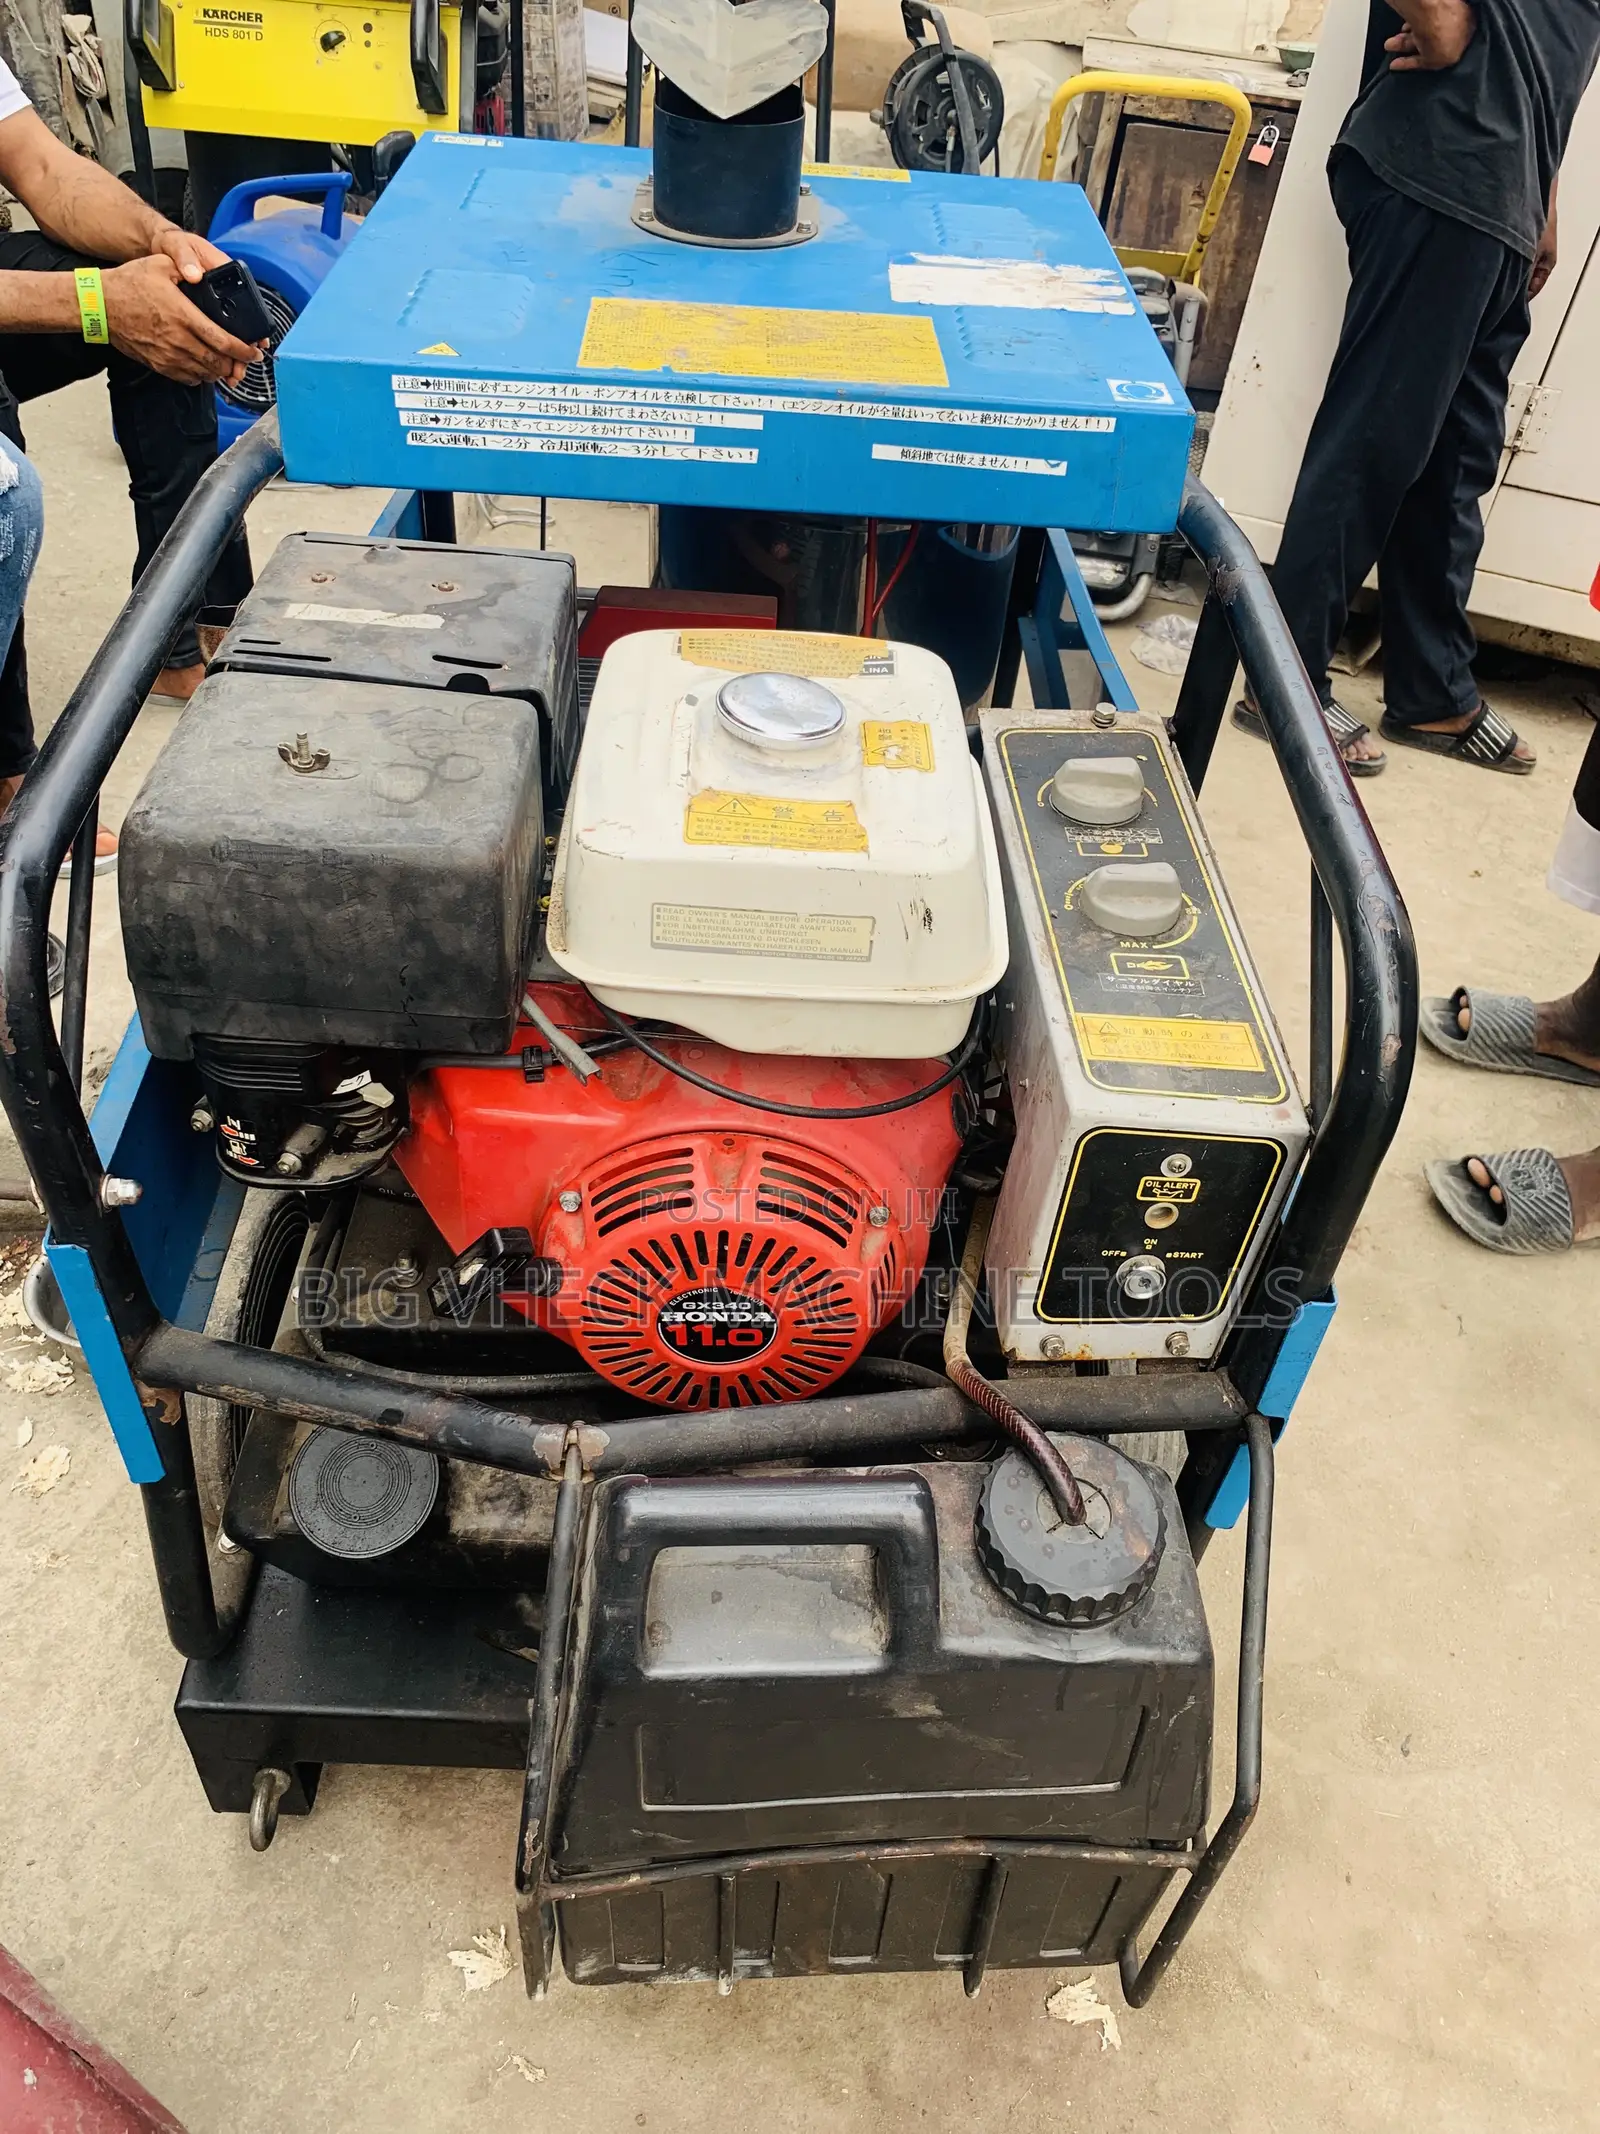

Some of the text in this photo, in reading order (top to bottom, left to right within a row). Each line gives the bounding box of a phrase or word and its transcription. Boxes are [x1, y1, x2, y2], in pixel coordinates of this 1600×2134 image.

[202, 7, 263, 23] KÄRCHER
[205, 27, 263, 41] HDS 801 D
[397, 377, 421, 390] 注意
[424, 396, 448, 408] 注意
[406, 413, 430, 425] 注意
[662, 907, 852, 926] READ OWNER'S MANUAL BEFORE OPERATION
[662, 914, 681, 922] LIRE
[696, 917, 730, 926] MANUEL
[800, 924, 826, 932] AVANT
[829, 925, 857, 933] USAGE
[759, 929, 808, 937] UNBEDINGT
[726, 940, 752, 948] ANTES
[767, 943, 793, 951] HABER
[1119, 941, 1149, 949] MAX
[1145, 1180, 1195, 1189] OIL ALERT
[1172, 1251, 1204, 1259] START
[669, 1286, 719, 1306] ELECTRONIC
[682, 1301, 752, 1310] GX340
[660, 1311, 776, 1322] HONDA
[665, 1323, 763, 1347] 11.0
